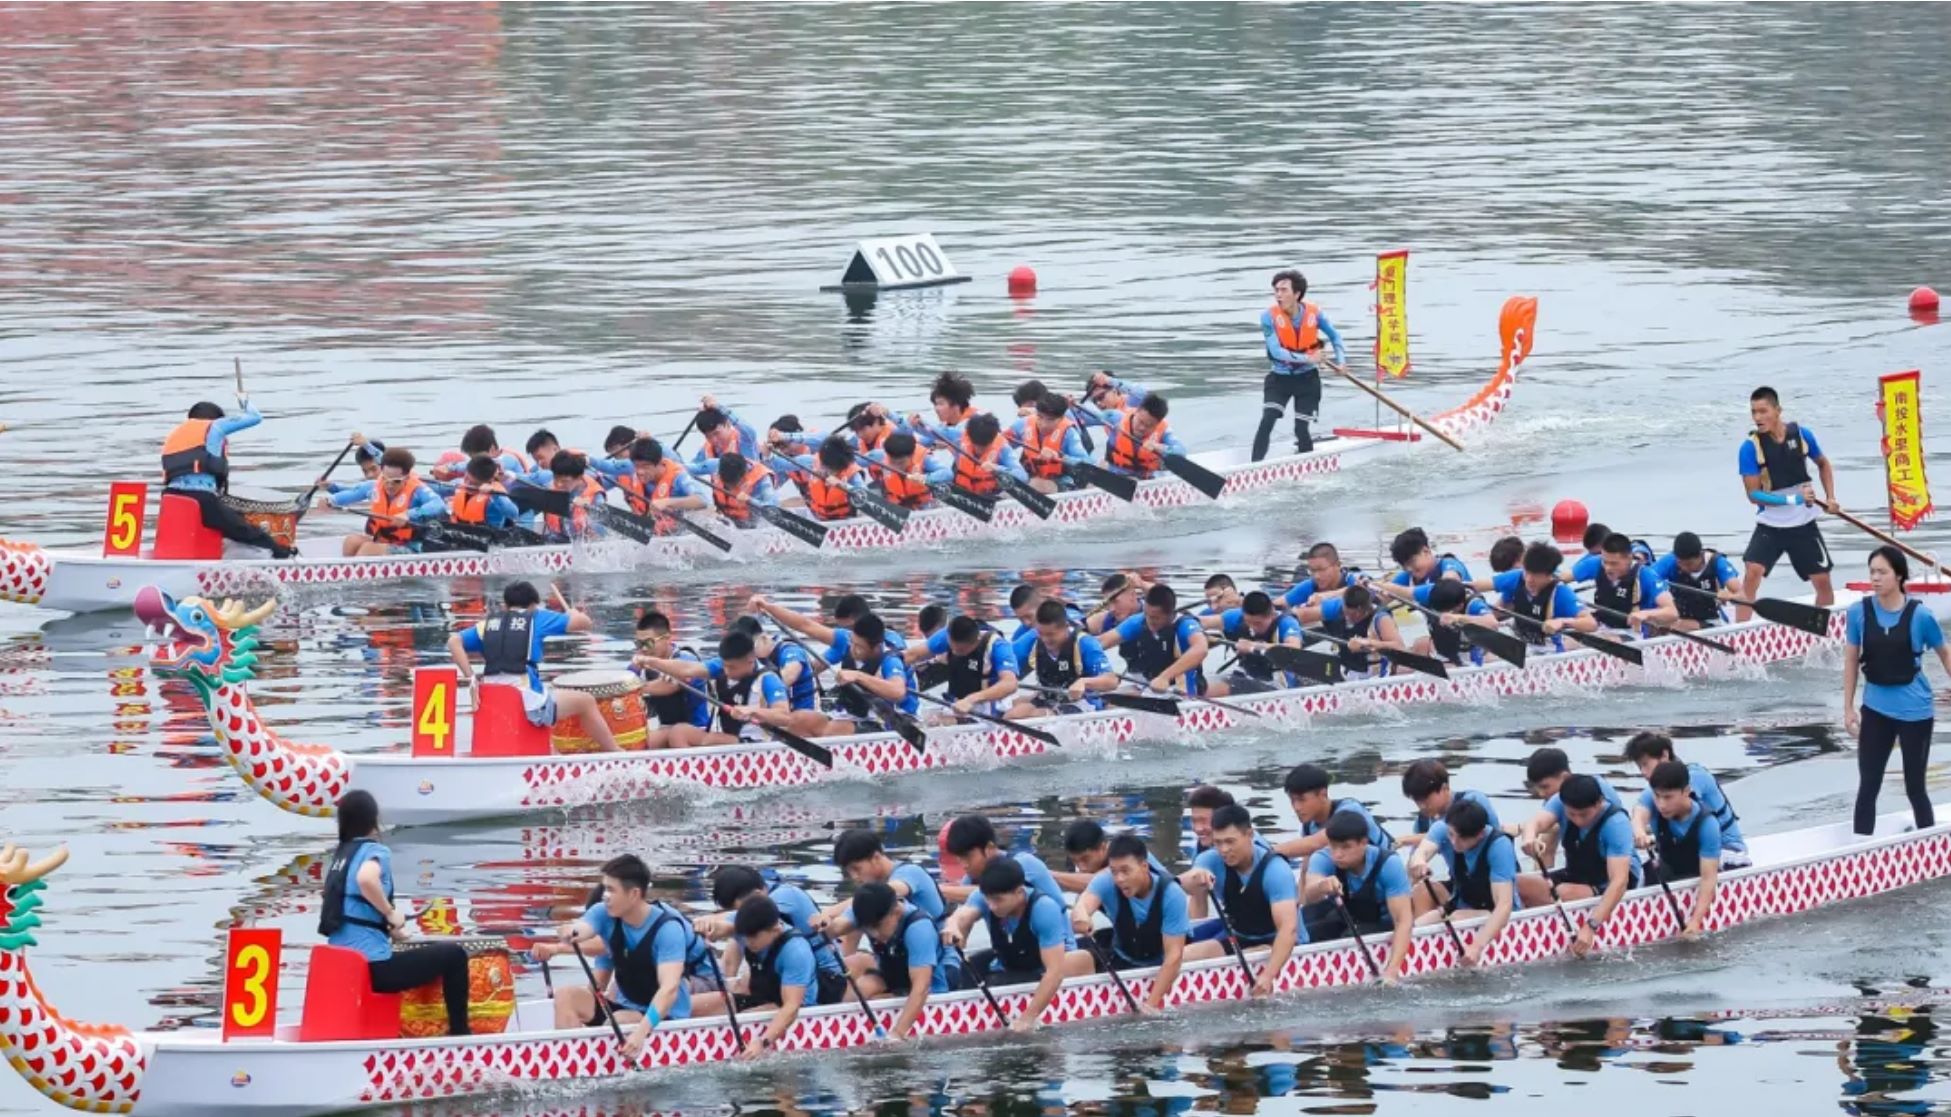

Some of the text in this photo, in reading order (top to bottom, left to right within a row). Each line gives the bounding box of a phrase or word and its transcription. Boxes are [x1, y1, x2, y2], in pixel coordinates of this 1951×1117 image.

[876, 242, 943, 279] 100
[1894, 391, 1913, 481] 南投水里商工
[111, 493, 139, 550] 5
[486, 616, 527, 631] 南投
[418, 682, 451, 749] 4
[232, 944, 271, 1027] 3
